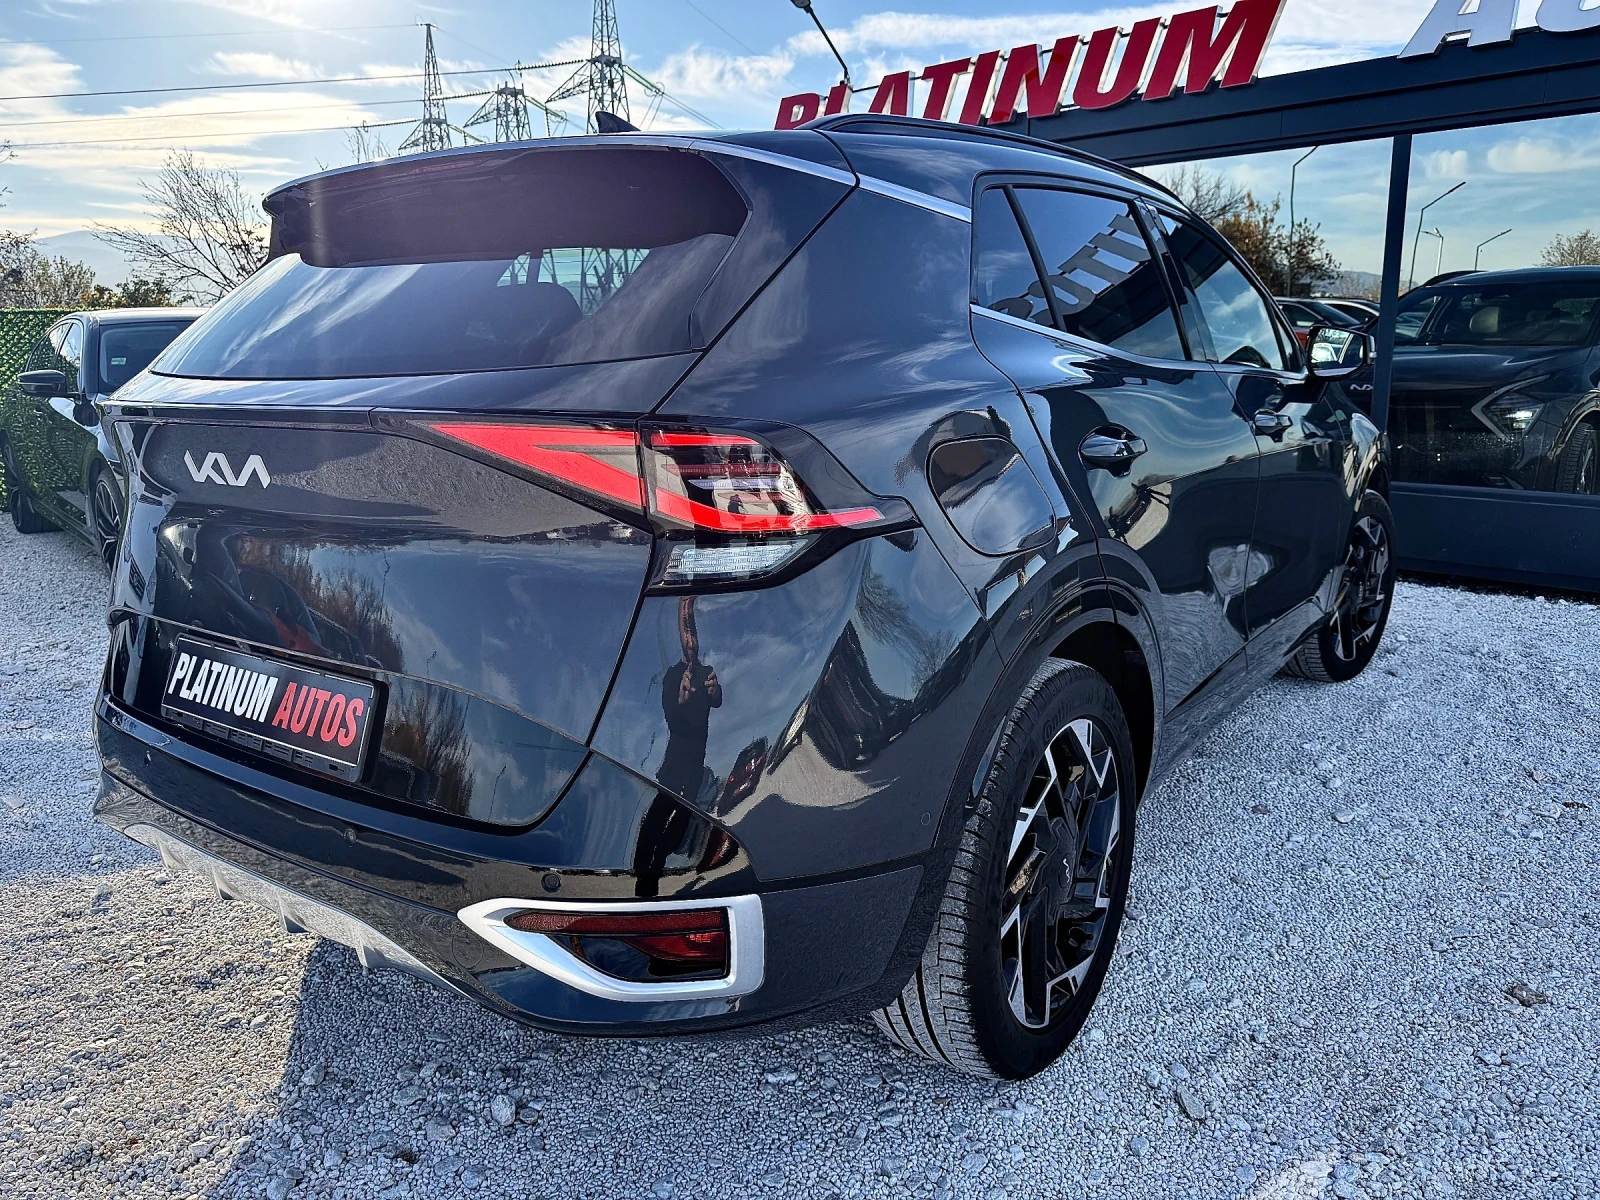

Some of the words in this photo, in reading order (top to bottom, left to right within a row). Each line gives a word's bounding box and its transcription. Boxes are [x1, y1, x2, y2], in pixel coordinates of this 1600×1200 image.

[184, 449, 271, 489] KIA
[167, 652, 279, 723] PLATINUM
[271, 681, 365, 748] AUTOS
